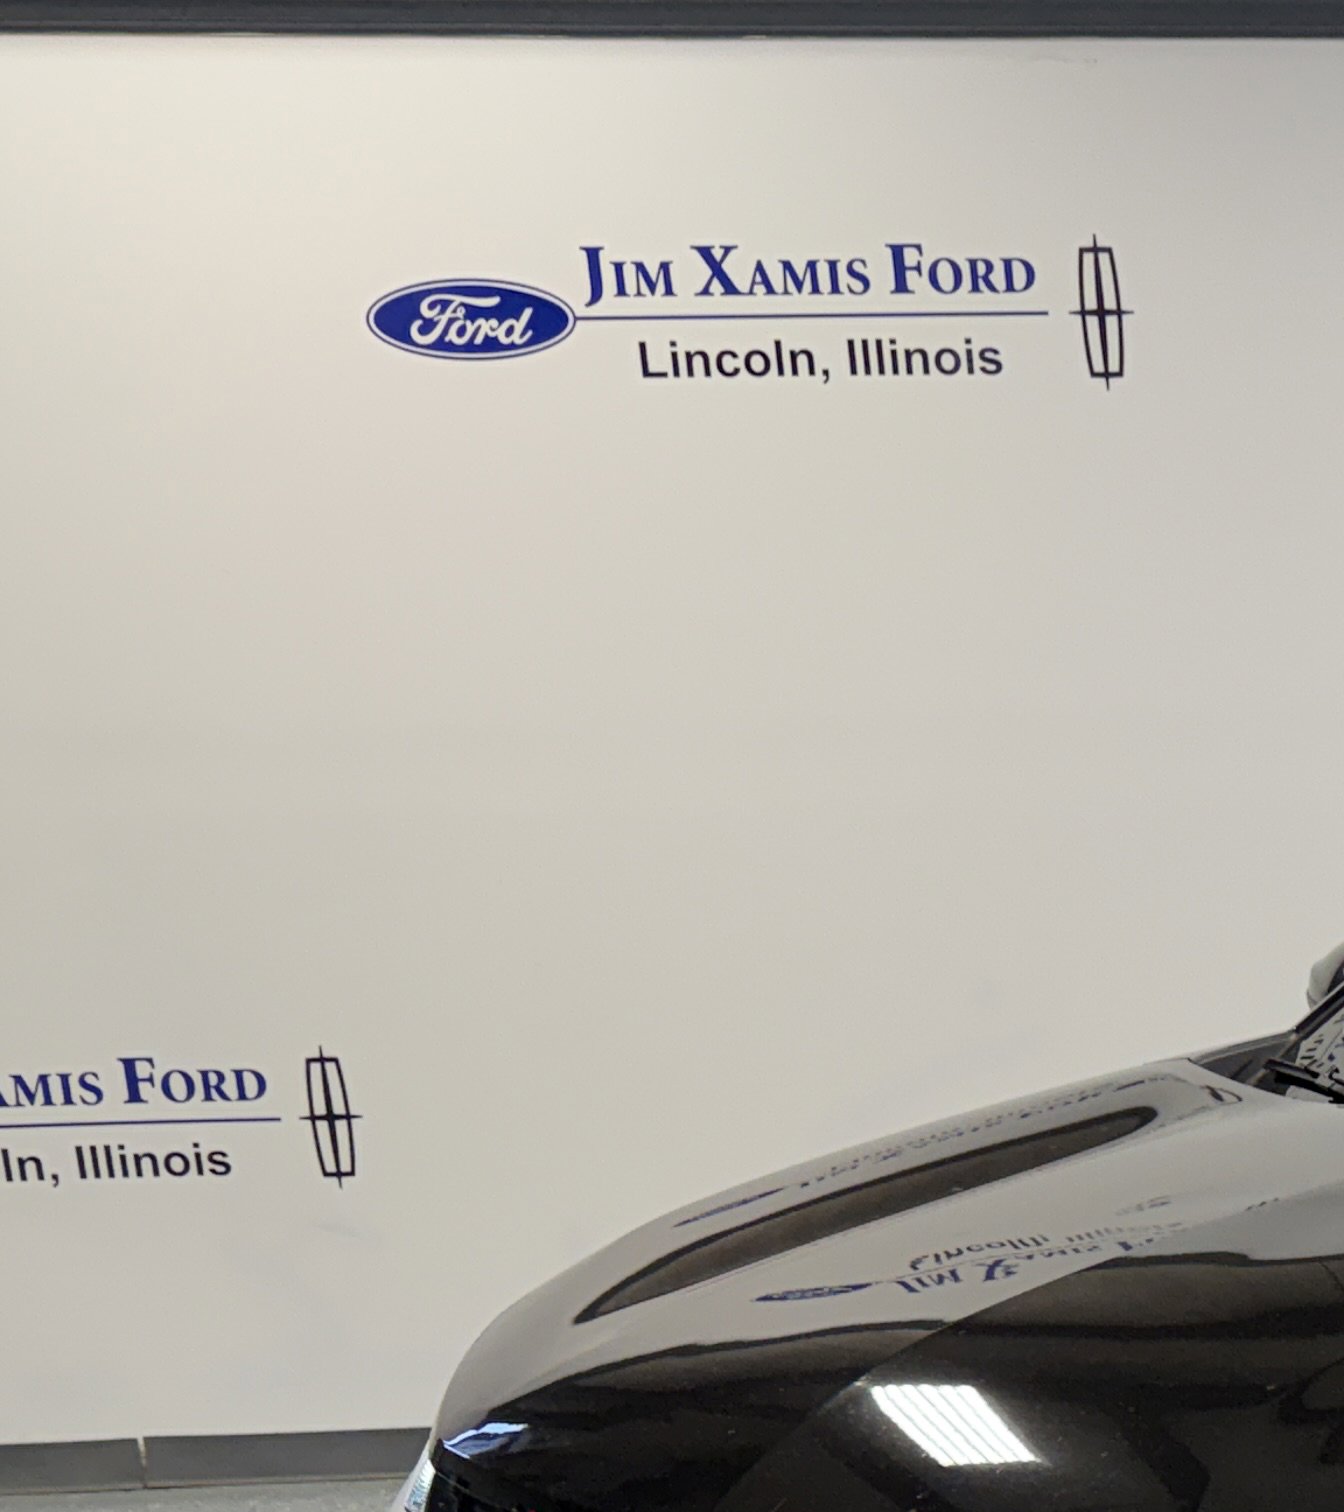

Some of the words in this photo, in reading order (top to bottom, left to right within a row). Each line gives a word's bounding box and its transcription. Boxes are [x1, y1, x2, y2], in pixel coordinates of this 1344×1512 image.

[579, 246, 677, 308] JIM
[690, 244, 872, 298] XAMIS
[884, 243, 1036, 295] FORD
[409, 293, 533, 347] Ford
[637, 338, 831, 386] Lincoln,
[845, 337, 1004, 378] Illinois
[0, 1071, 105, 1109] MIS
[117, 1057, 267, 1105] FORD
[74, 1142, 232, 1180] Illinois
